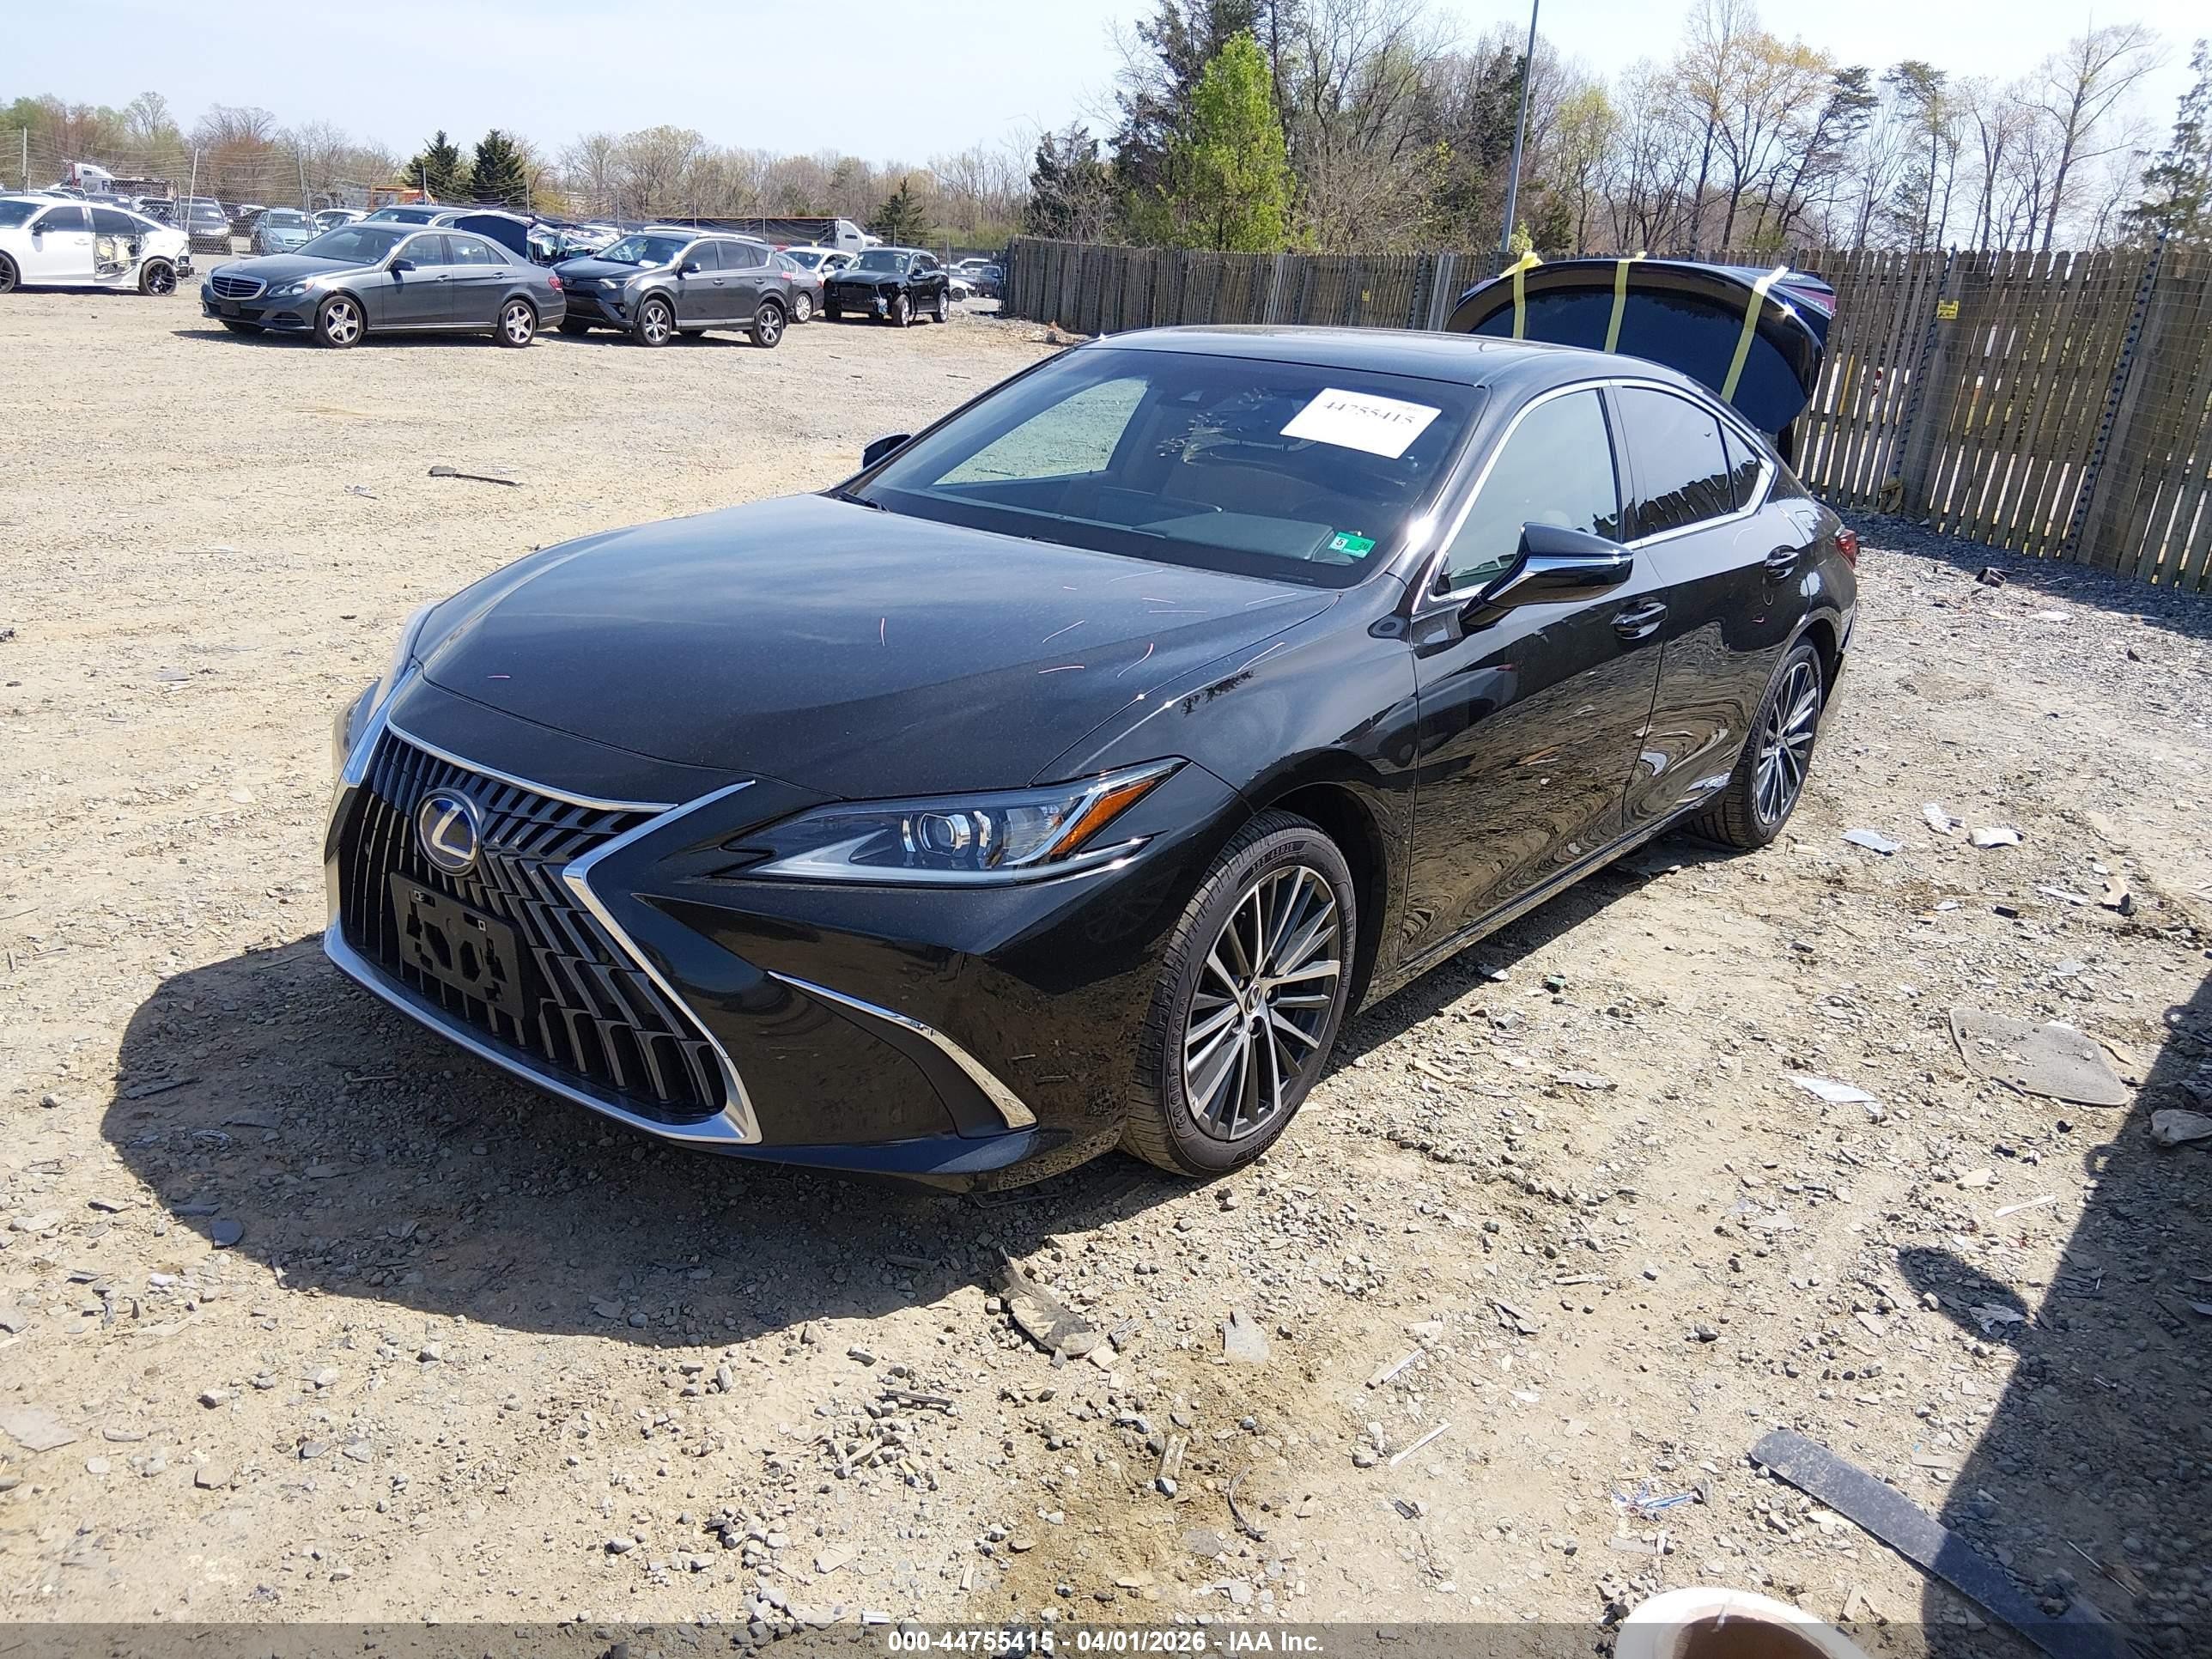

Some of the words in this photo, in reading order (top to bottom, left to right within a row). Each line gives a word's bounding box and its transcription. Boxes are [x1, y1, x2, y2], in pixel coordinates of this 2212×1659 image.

[1323, 401, 1416, 424] 44755415
[1336, 538, 1345, 546] 5
[1167, 996, 1190, 1129] GOODYEAR
